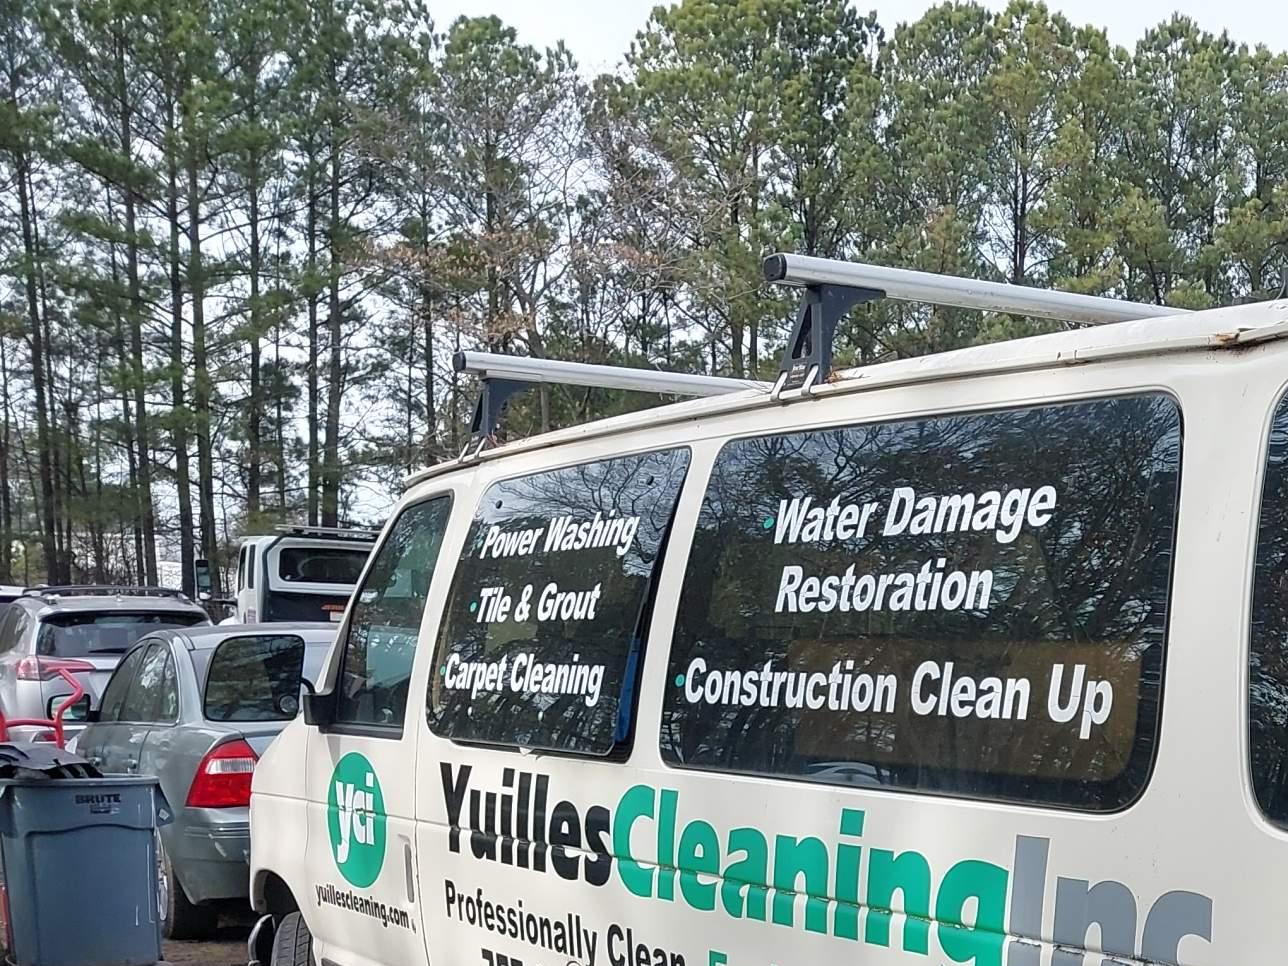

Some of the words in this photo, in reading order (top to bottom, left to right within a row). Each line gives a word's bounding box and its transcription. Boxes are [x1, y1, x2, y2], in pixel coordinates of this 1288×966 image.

[479, 526, 541, 560] Power
[544, 512, 640, 557] Washing
[773, 497, 876, 545] Water
[883, 484, 1056, 544] Damage
[477, 587, 510, 623] Tile
[514, 586, 531, 621] &
[537, 584, 601, 622] Grout
[774, 559, 994, 614] Restoration
[444, 660, 507, 700] Carpet
[510, 653, 605, 706] Cleaning
[684, 657, 898, 713] Construction
[911, 660, 1031, 719] Clean
[1047, 663, 1113, 740] Up
[335, 772, 375, 864] yci
[316, 884, 410, 930] yuillescleaning.com
